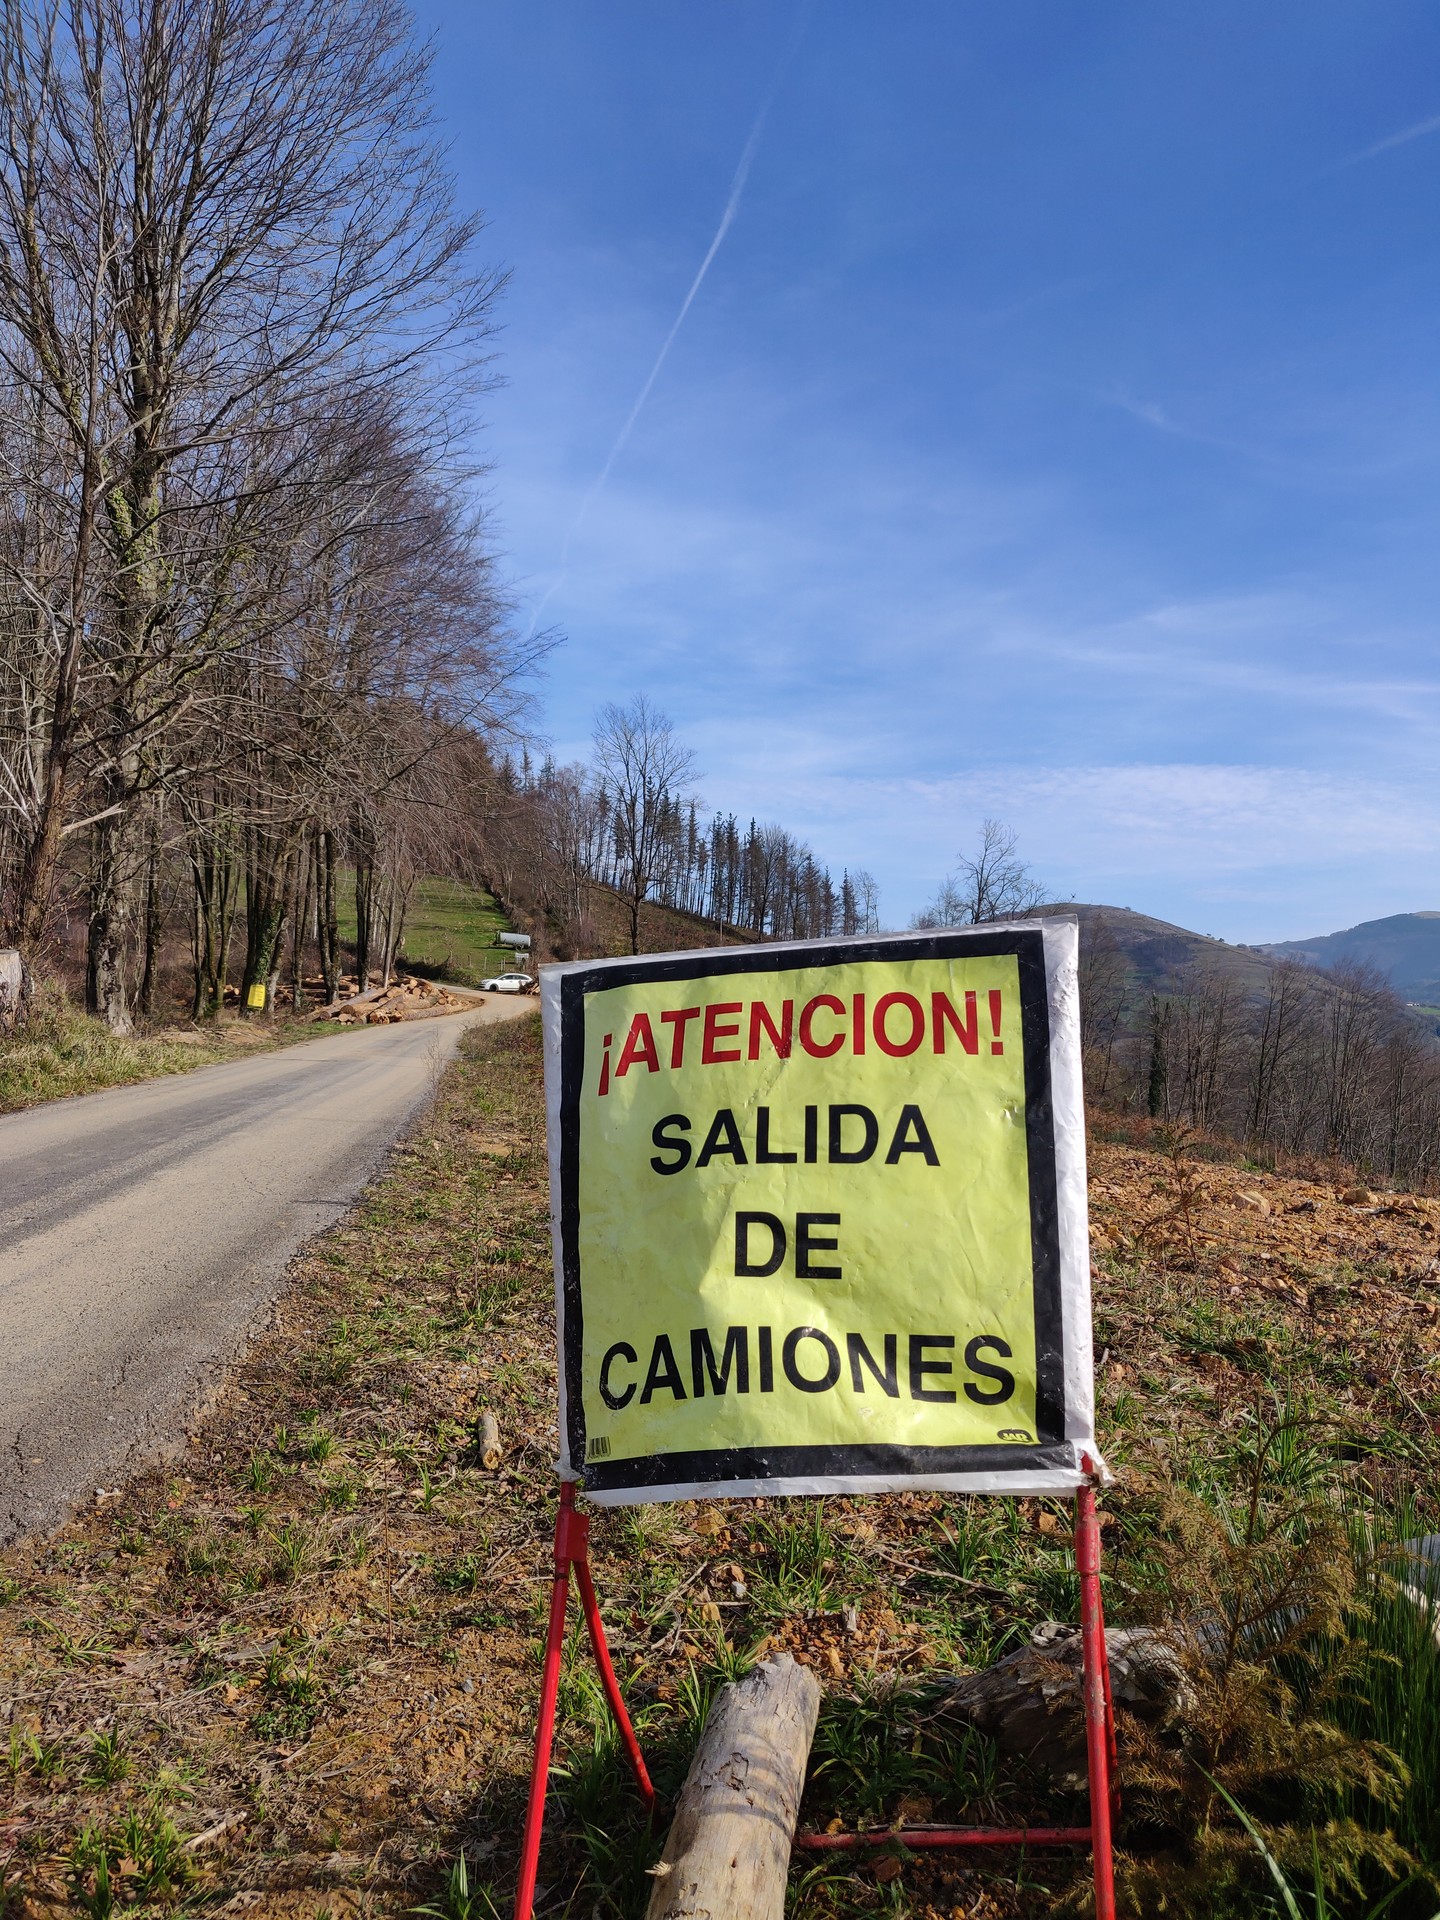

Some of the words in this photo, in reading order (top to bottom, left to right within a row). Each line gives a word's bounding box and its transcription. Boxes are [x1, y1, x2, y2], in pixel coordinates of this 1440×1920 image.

[598, 990, 1004, 1096] ¡ATENCION!
[650, 1104, 940, 1175] SALIDA
[734, 1211, 842, 1280] DE
[599, 1326, 1016, 1410] CAMIONES
